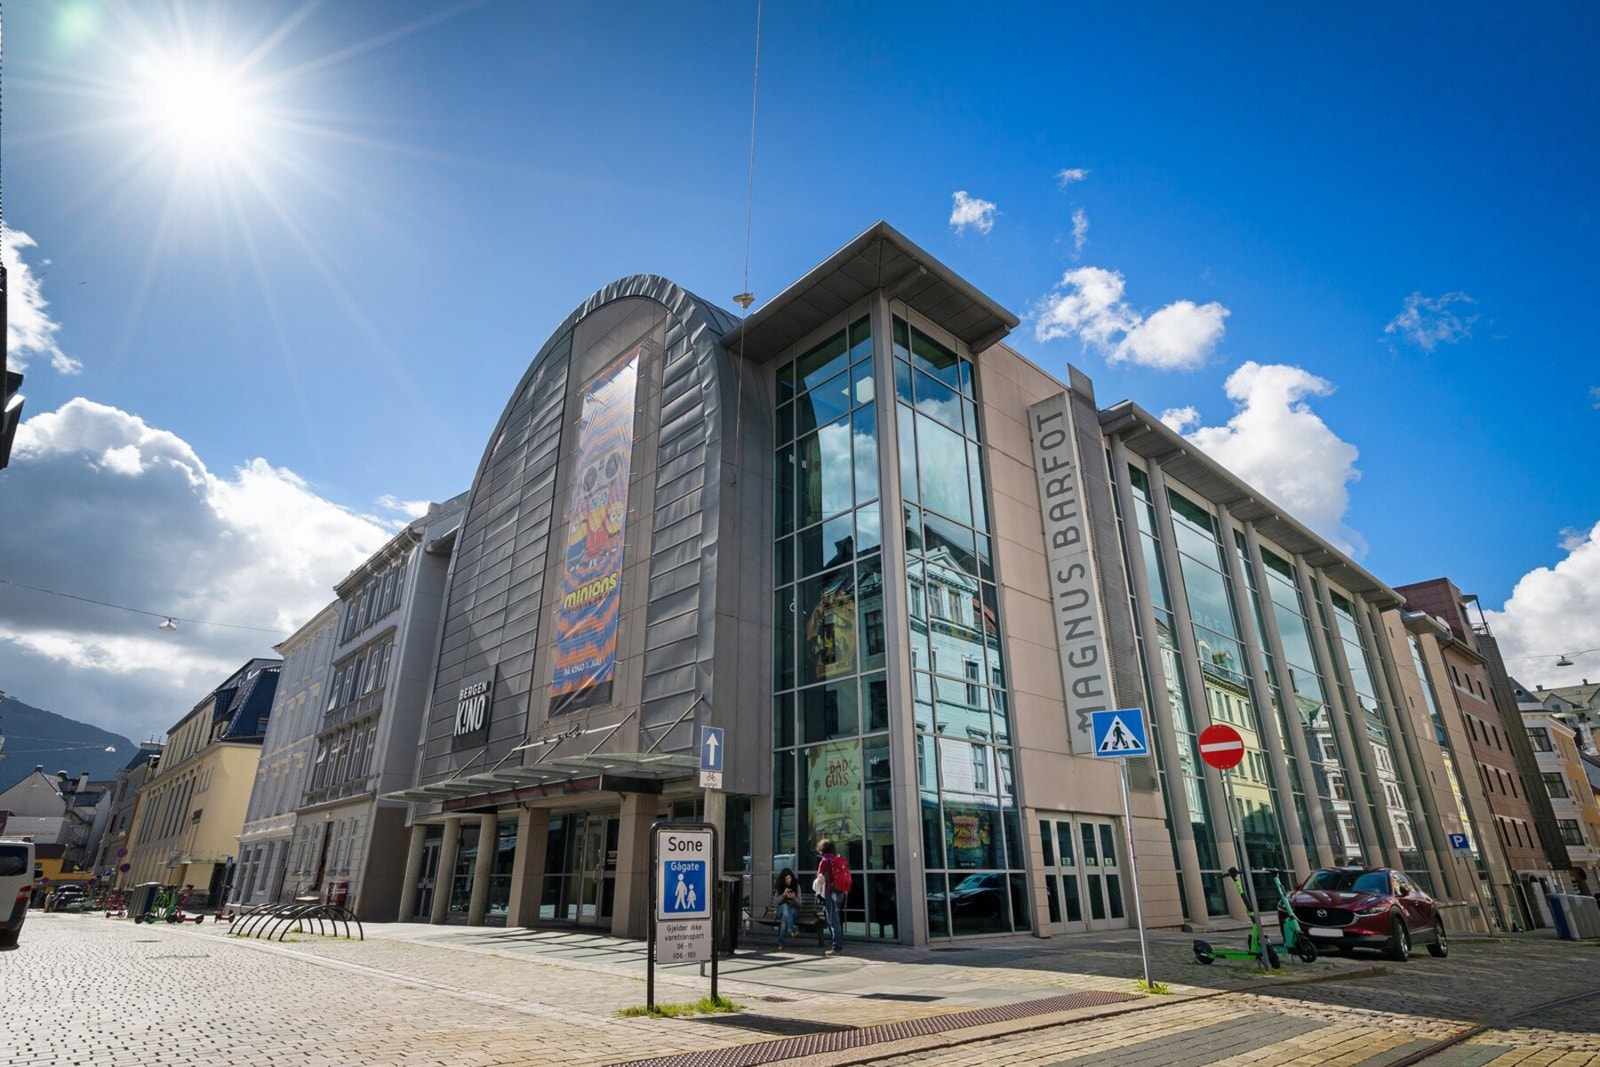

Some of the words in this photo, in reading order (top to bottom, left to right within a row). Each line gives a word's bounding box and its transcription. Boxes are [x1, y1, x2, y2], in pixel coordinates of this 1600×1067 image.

[1036, 411, 1081, 549] BARFOT
[1057, 563, 1107, 734] MAGNUS
[459, 680, 487, 700] BERGEN
[829, 759, 849, 774] BAD
[825, 772, 849, 788] GUYS
[668, 836, 703, 851] Sone
[1453, 835, 1464, 848] P
[670, 861, 700, 873] Gågate
[666, 924, 688, 934] Gjelder
[664, 933, 705, 941] varetransport
